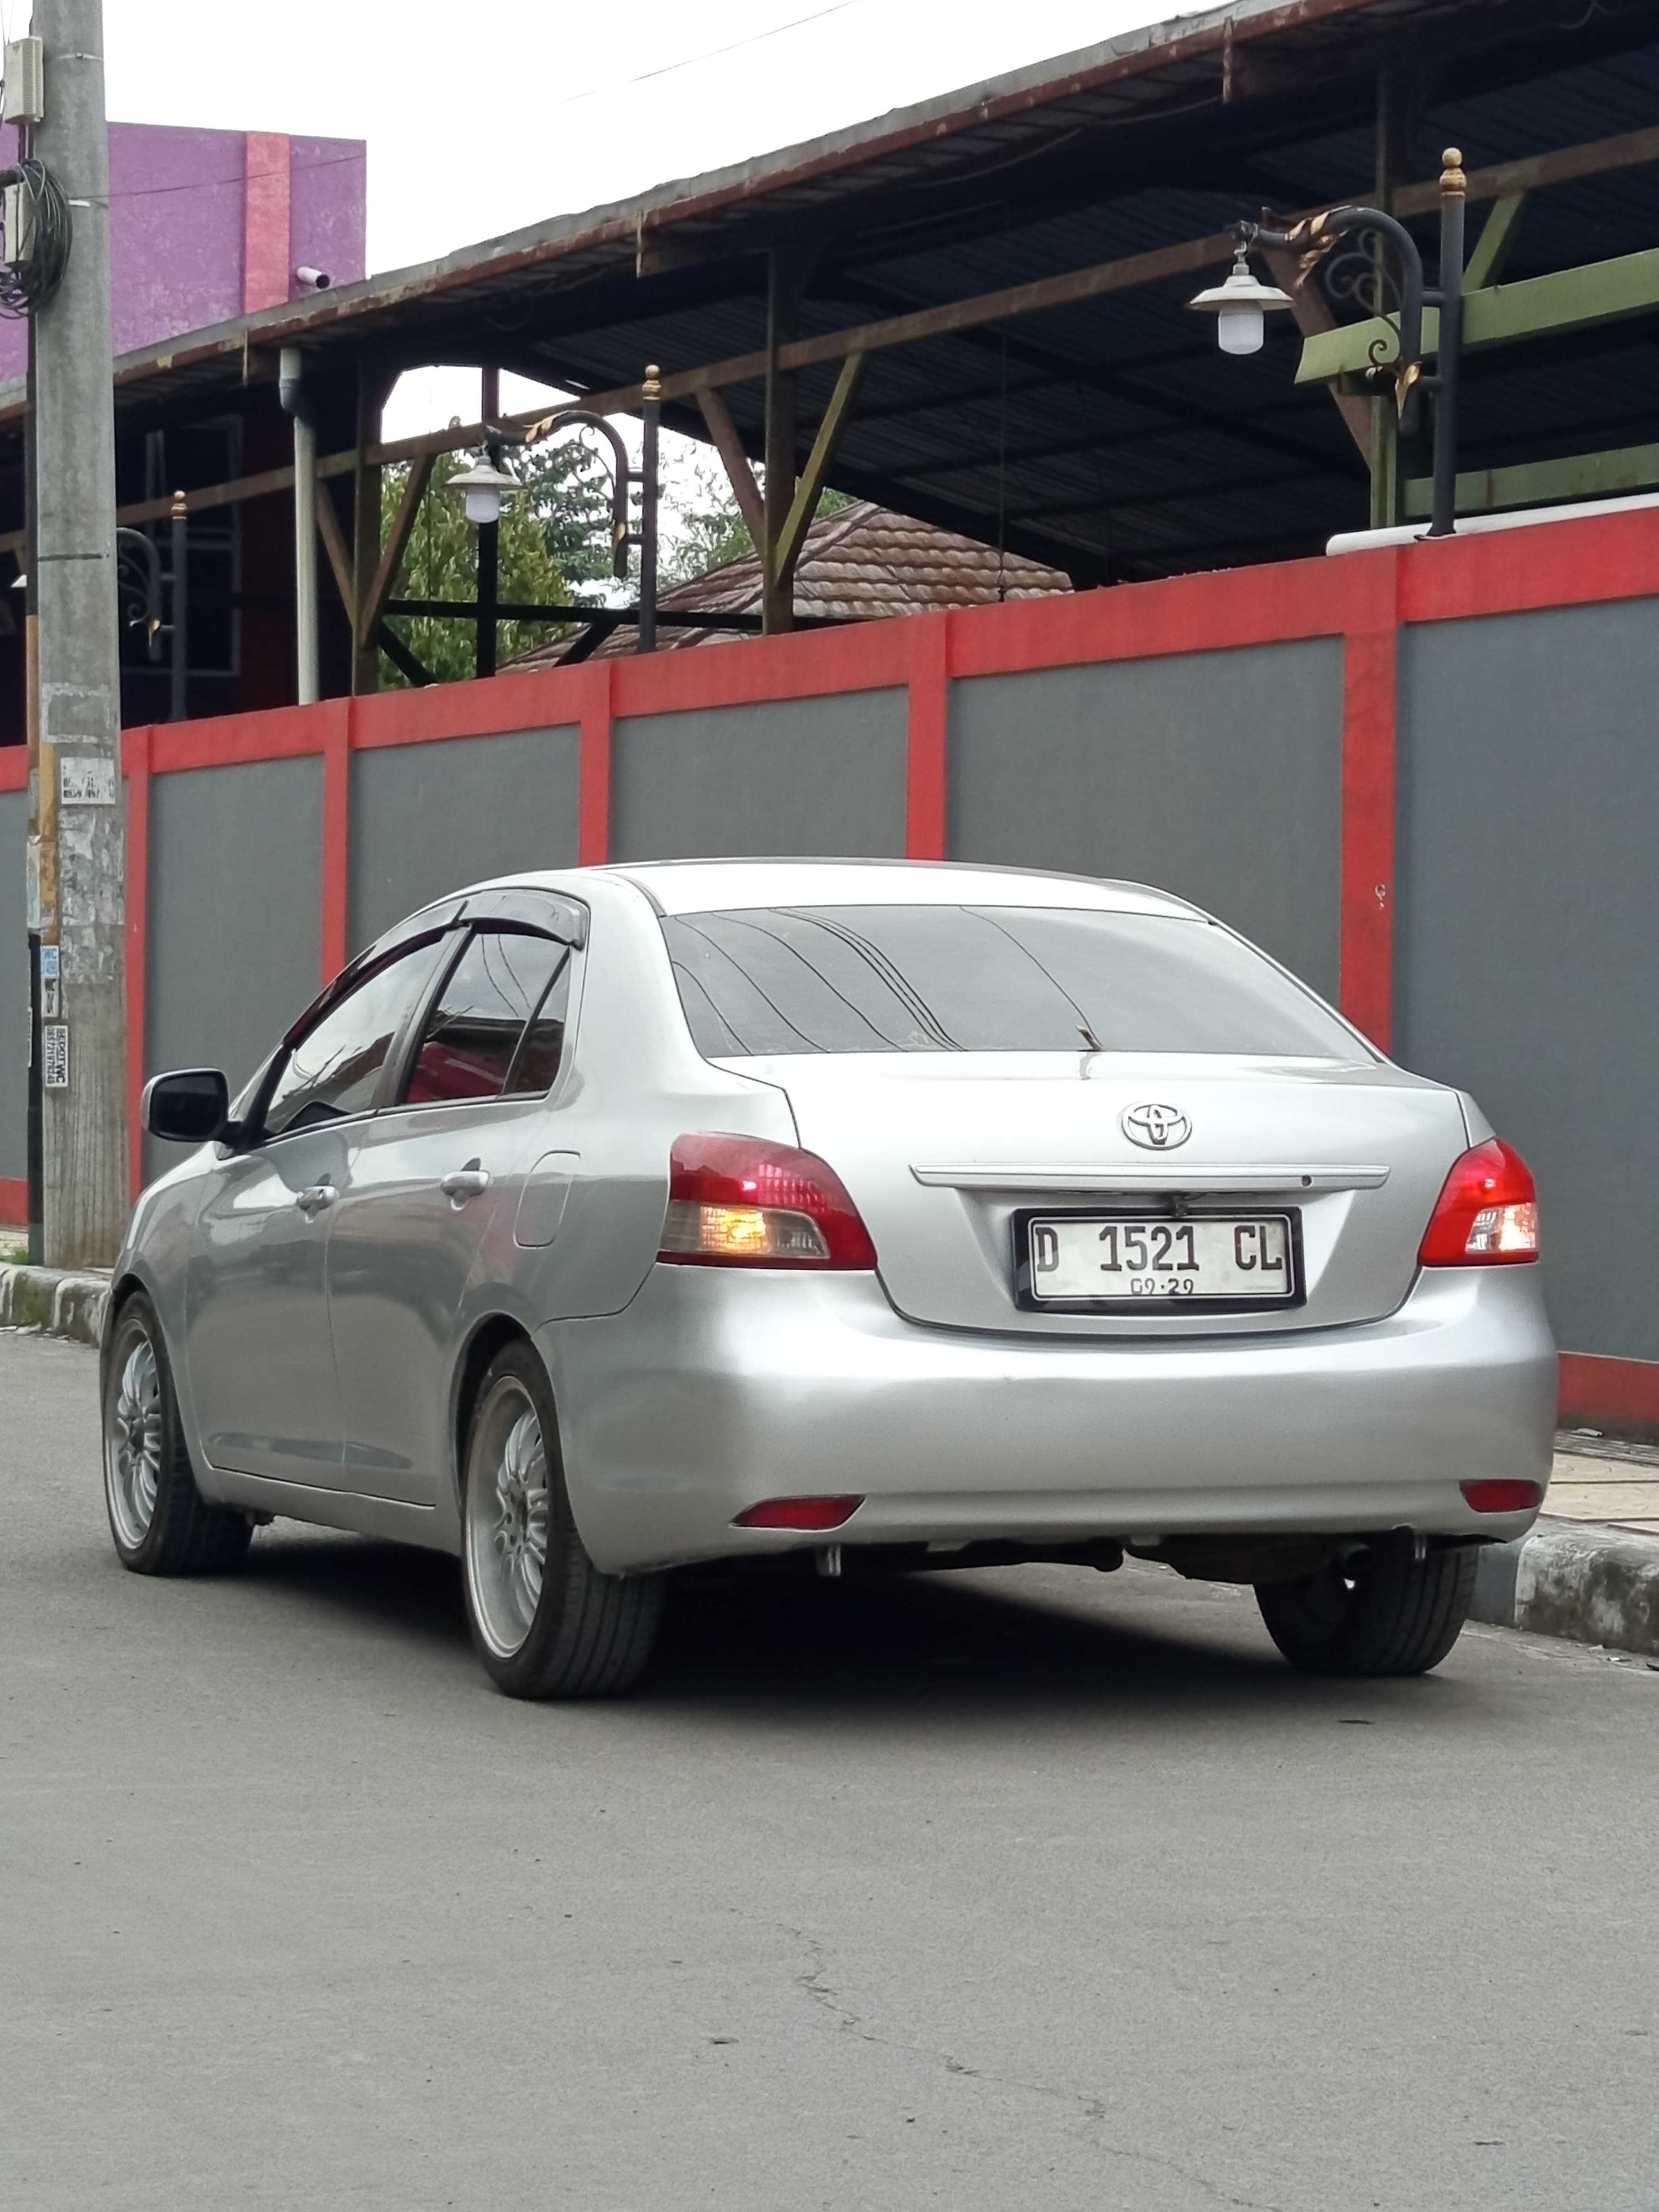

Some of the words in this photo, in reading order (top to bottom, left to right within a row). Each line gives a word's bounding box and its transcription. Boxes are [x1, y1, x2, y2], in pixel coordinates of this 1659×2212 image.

[56, 1064, 66, 1083] WC
[1036, 1227, 1059, 1272] D
[1099, 1225, 1199, 1271] 1521
[1234, 1225, 1283, 1270] CL
